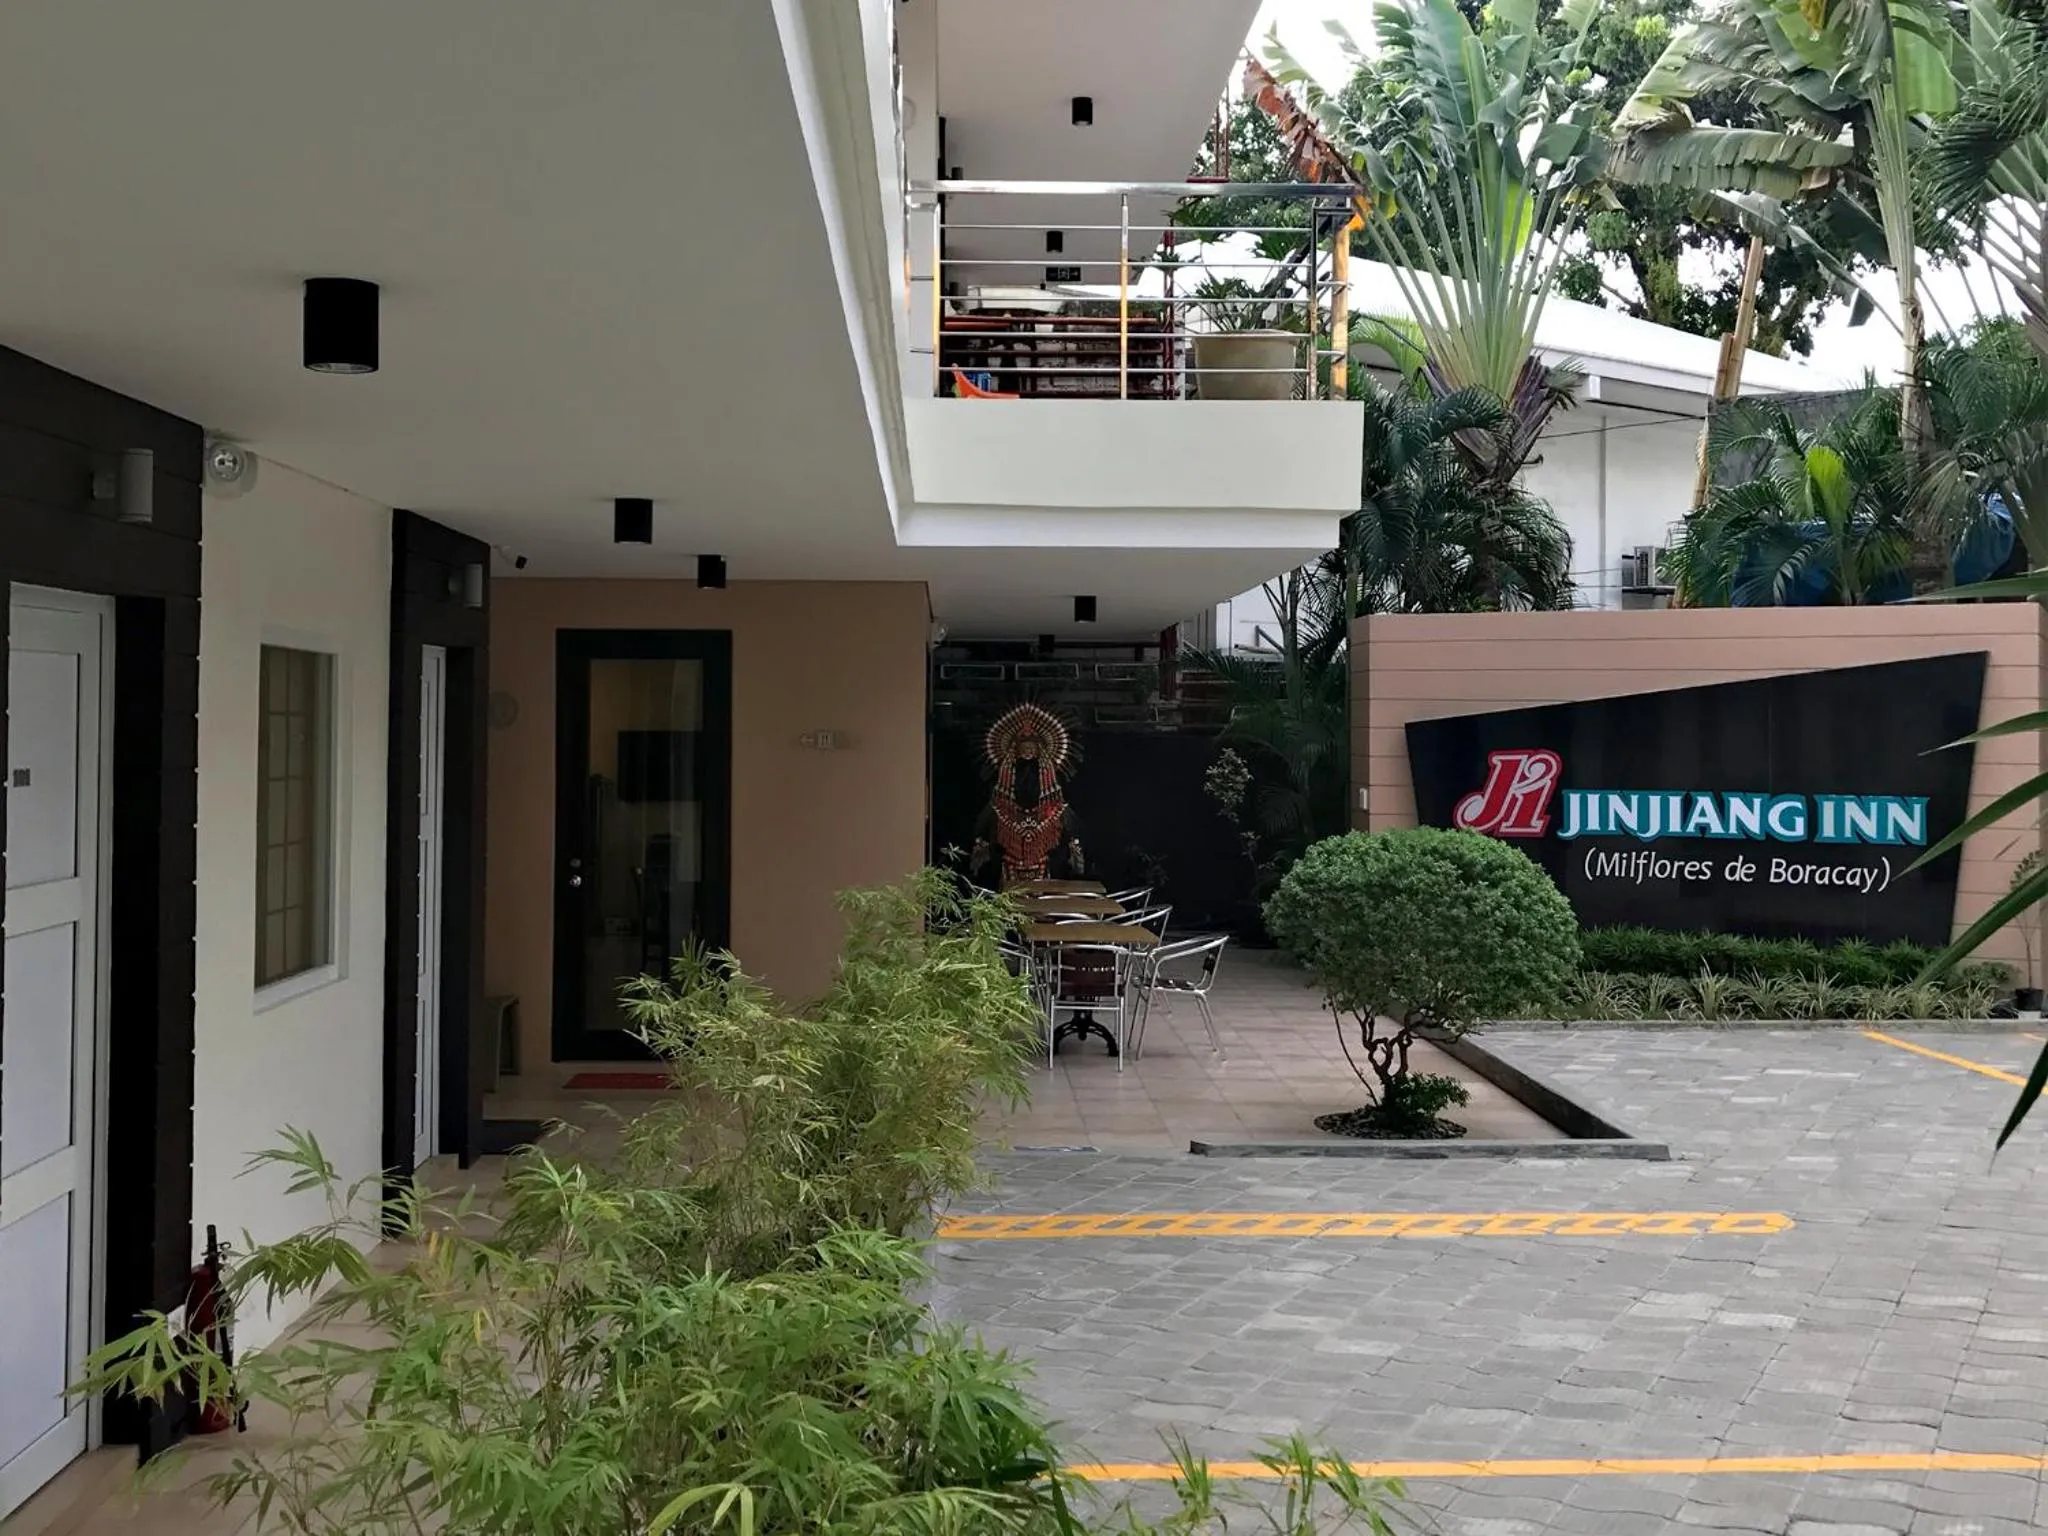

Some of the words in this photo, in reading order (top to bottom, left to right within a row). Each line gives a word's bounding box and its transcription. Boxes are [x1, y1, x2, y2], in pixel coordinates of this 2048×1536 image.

[1557, 791, 1807, 841] JINJIANG
[1815, 796, 1928, 844] INN
[1584, 847, 1713, 885] (Milflores
[1724, 855, 1757, 883] de
[1769, 856, 1891, 893] Boracay)
